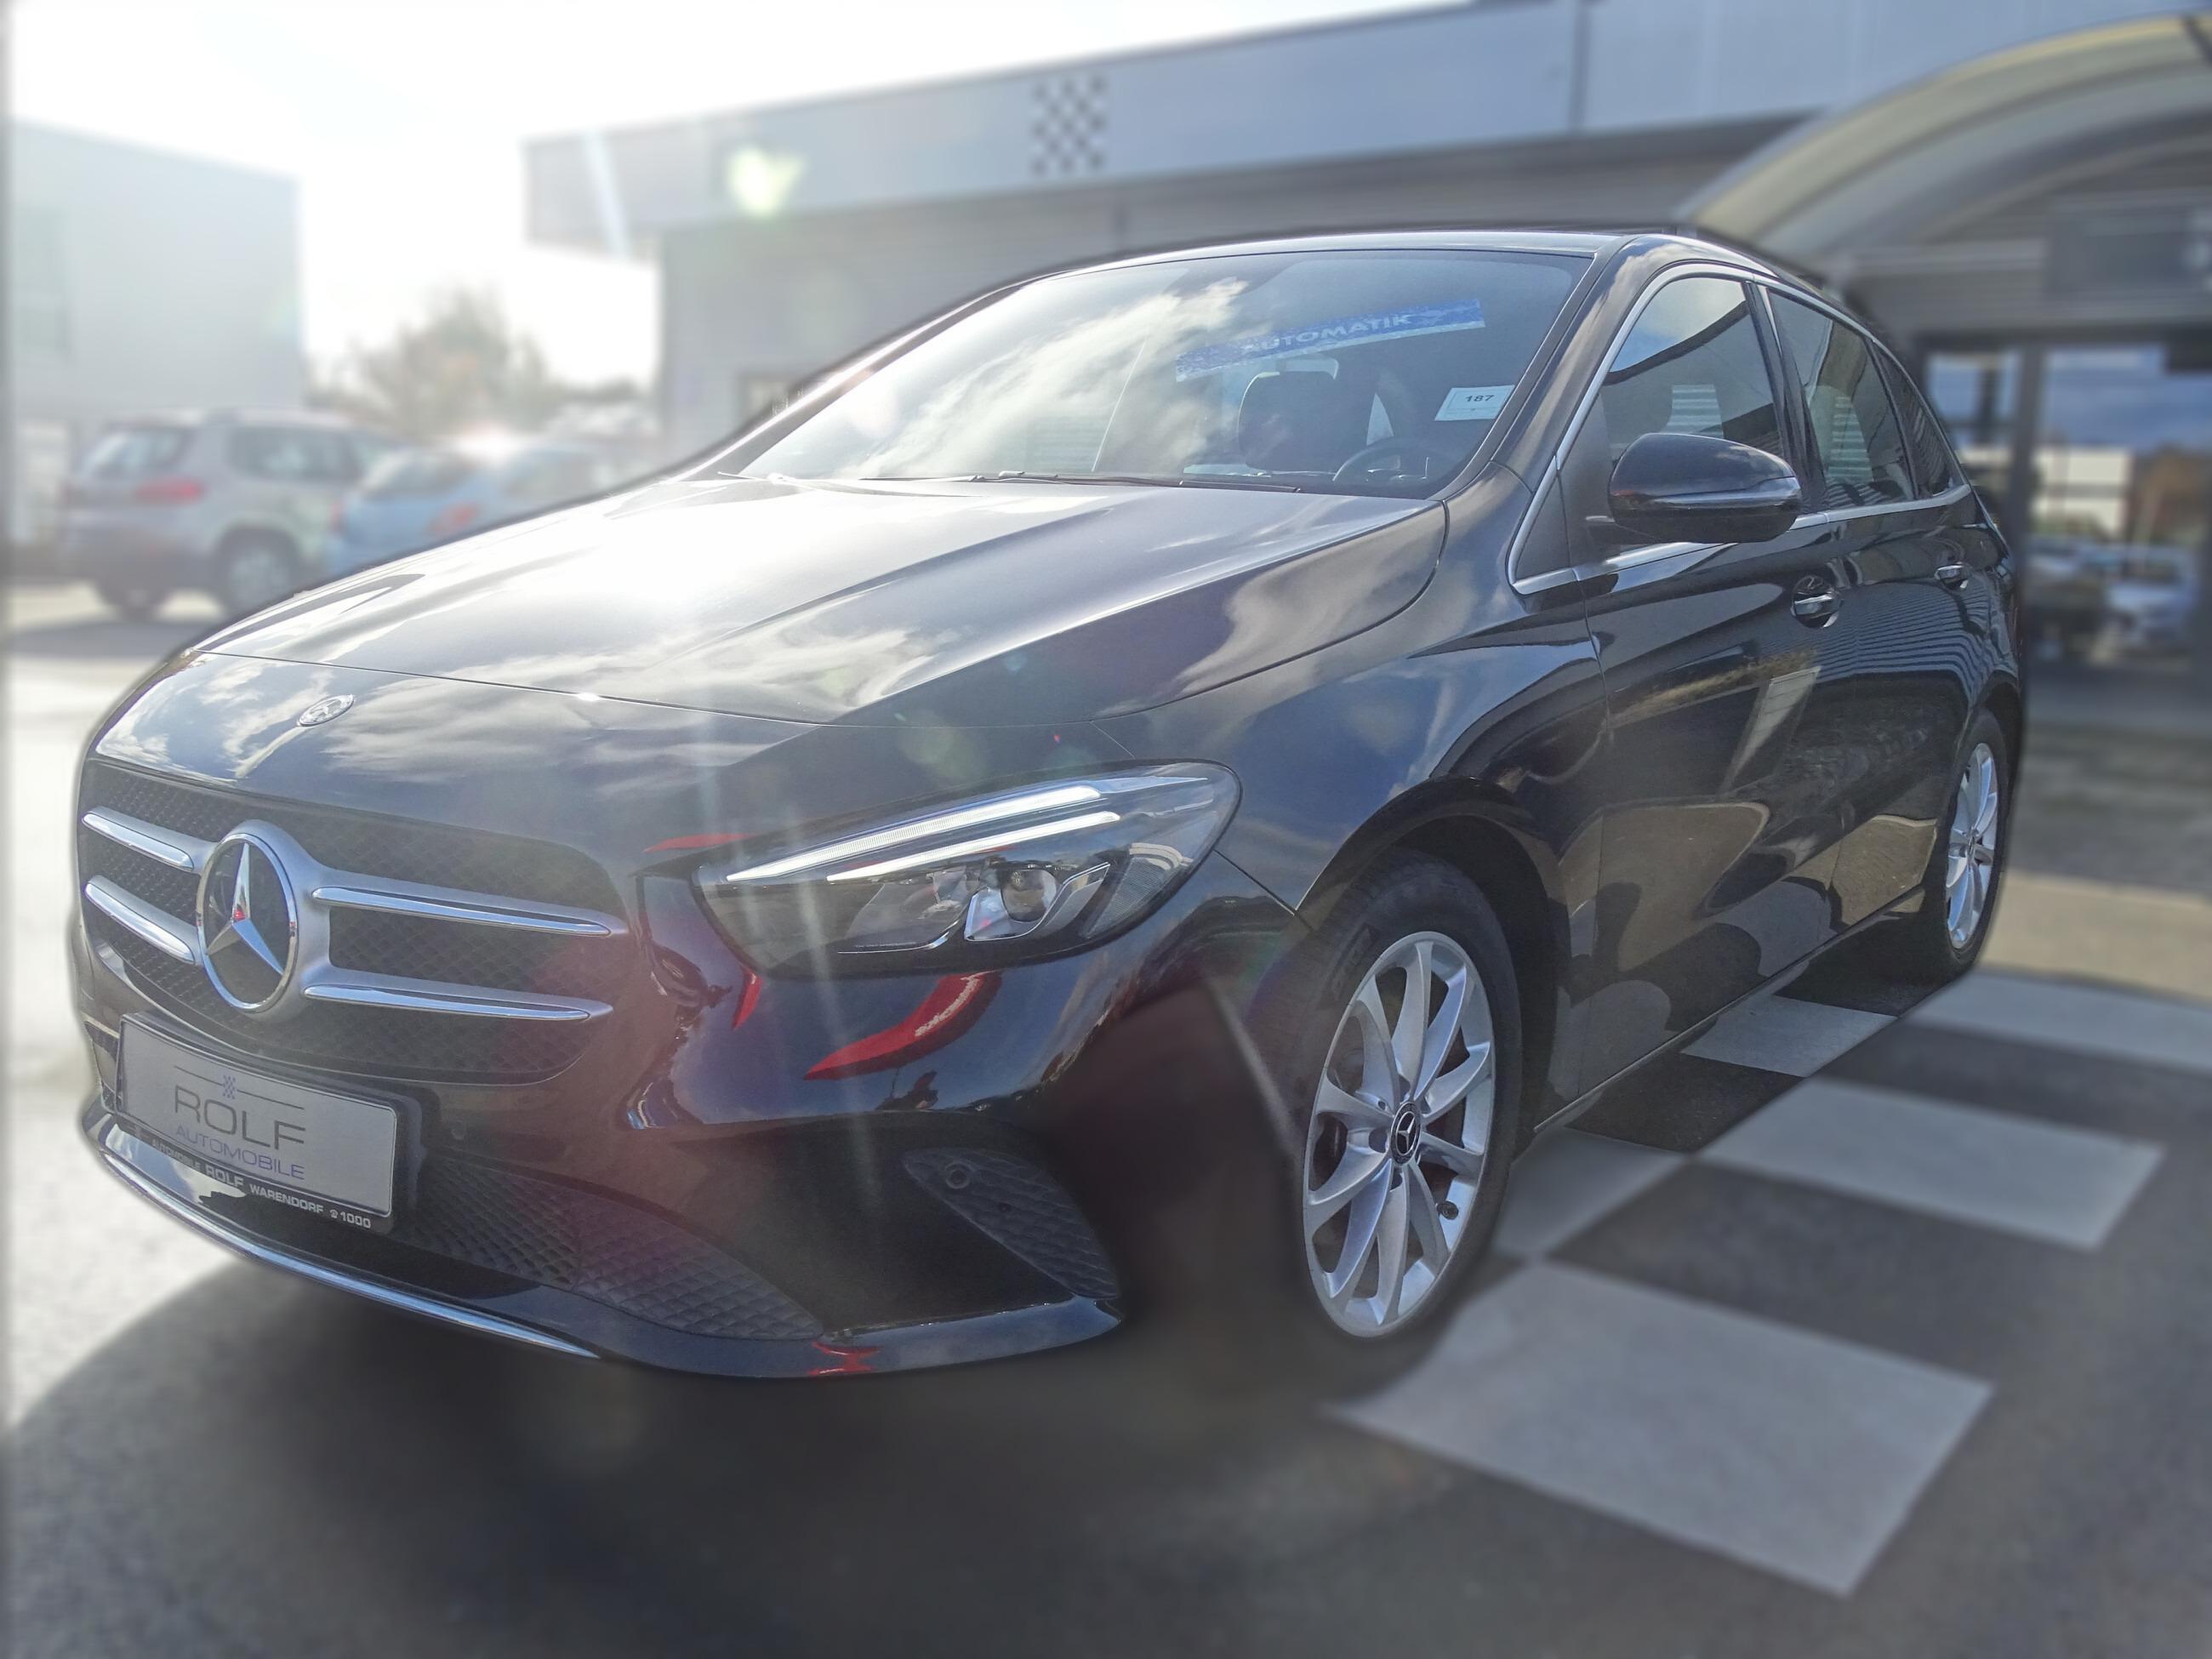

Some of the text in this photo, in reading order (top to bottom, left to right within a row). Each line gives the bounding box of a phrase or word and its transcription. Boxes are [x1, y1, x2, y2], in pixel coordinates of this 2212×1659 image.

[1465, 394, 1495, 402] 187
[174, 1084, 306, 1150] ROLF
[175, 1124, 305, 1181] AUTOMOBILE
[206, 1163, 244, 1187] ROLF
[249, 1183, 324, 1214] WARENDORF
[339, 1211, 372, 1229] 1000
